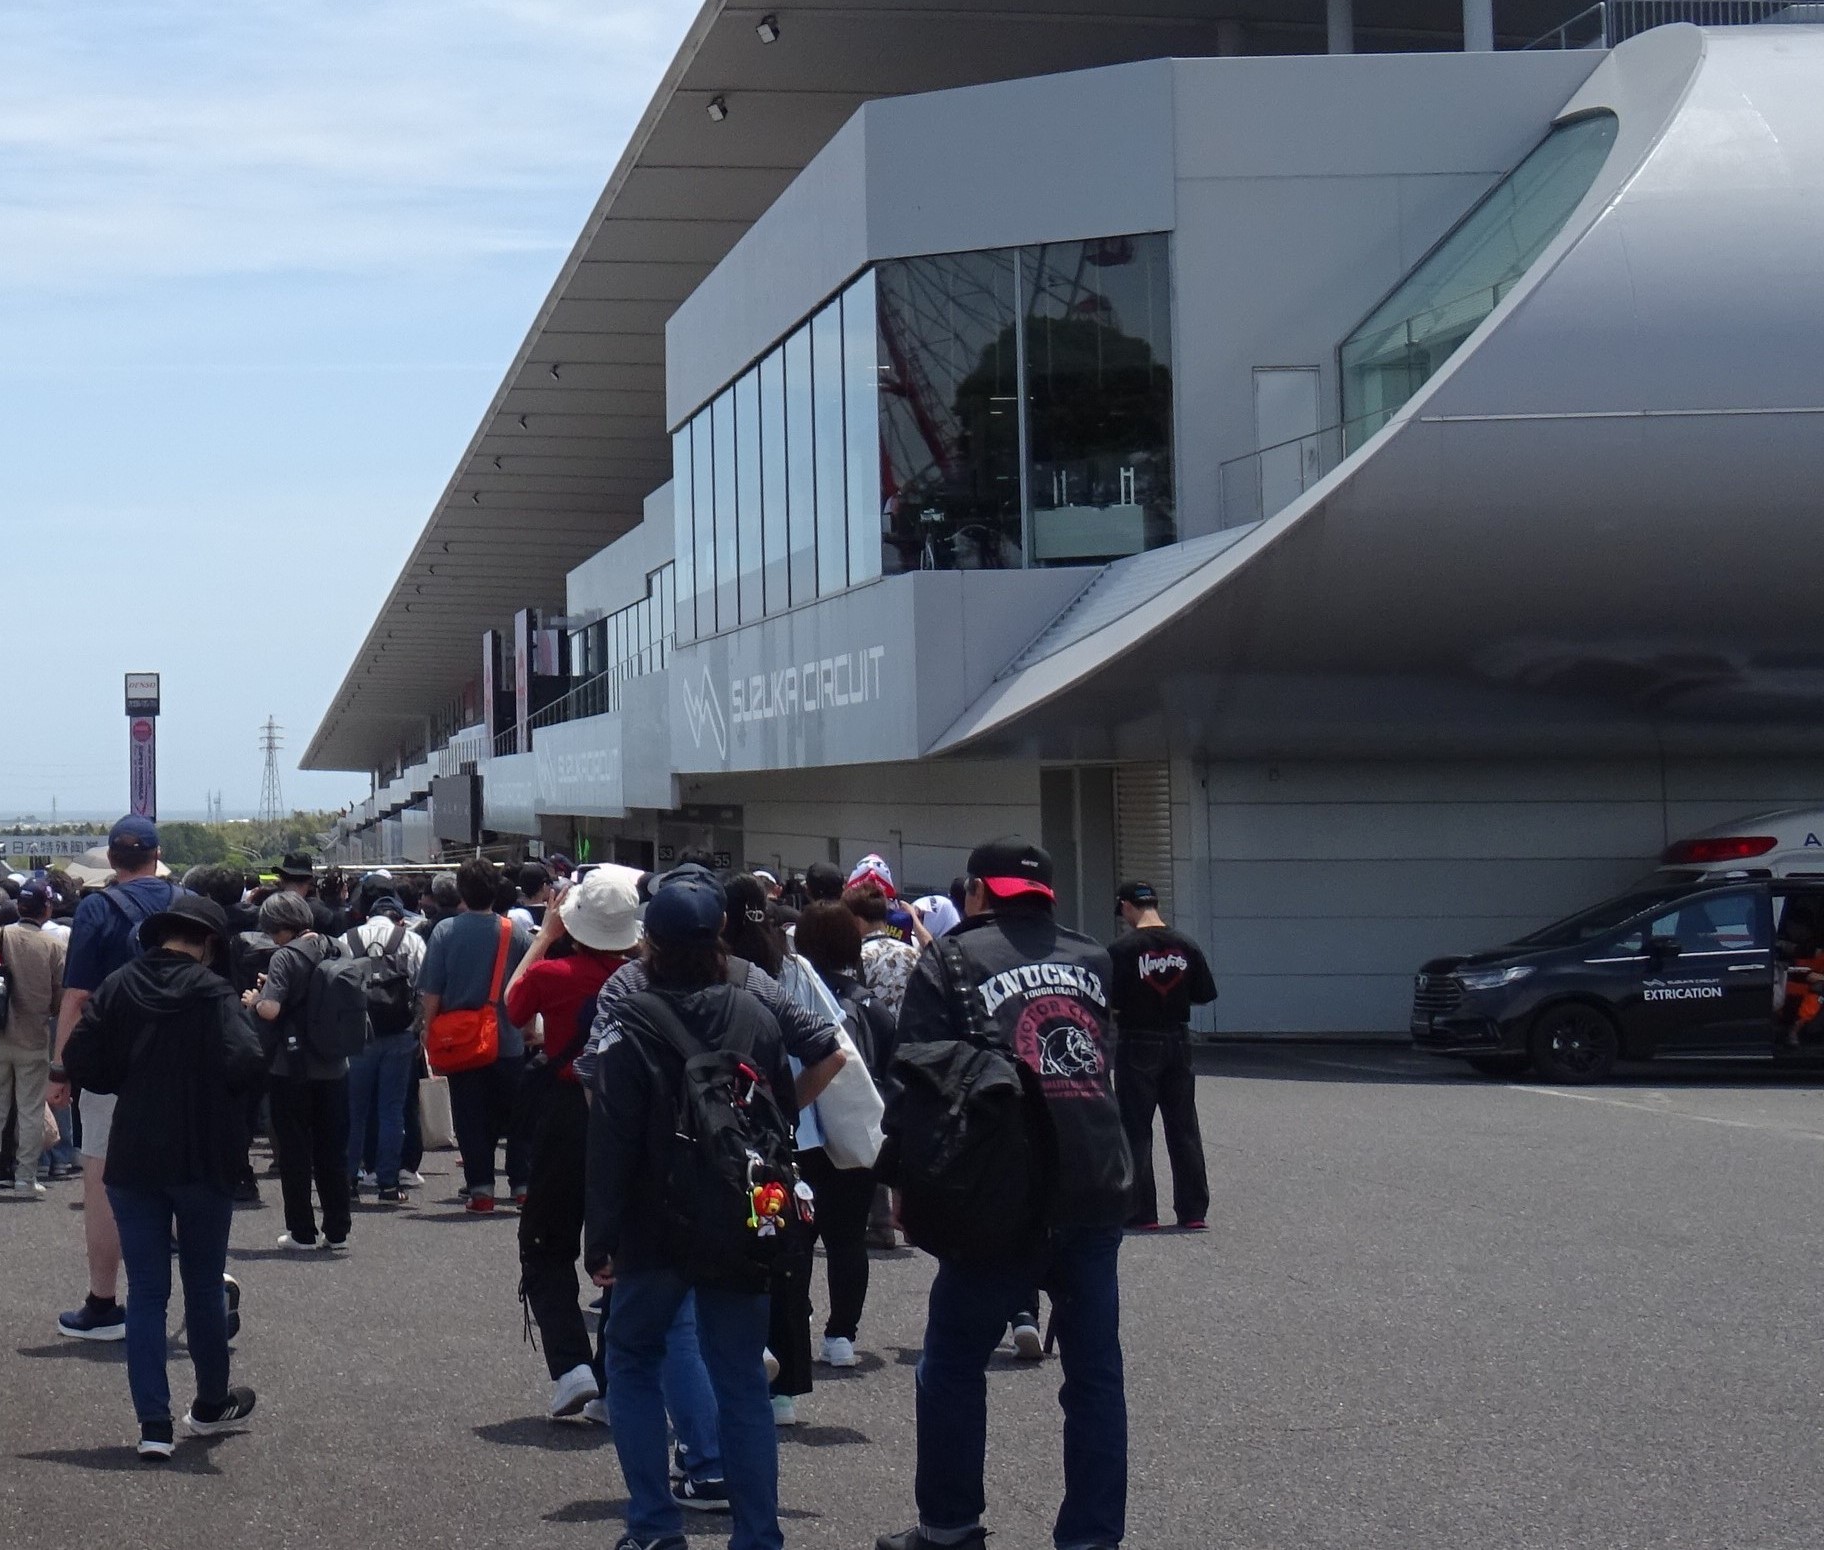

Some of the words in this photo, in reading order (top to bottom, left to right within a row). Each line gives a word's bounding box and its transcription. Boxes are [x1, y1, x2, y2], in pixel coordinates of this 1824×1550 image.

[731, 667, 798, 723] SUZUKA
[802, 644, 885, 712] CIRCUIT
[1023, 986, 1054, 1000] TOUGH
[1643, 986, 1722, 1001] EXTRICATION
[1018, 1001, 1060, 1056] MOTOR
